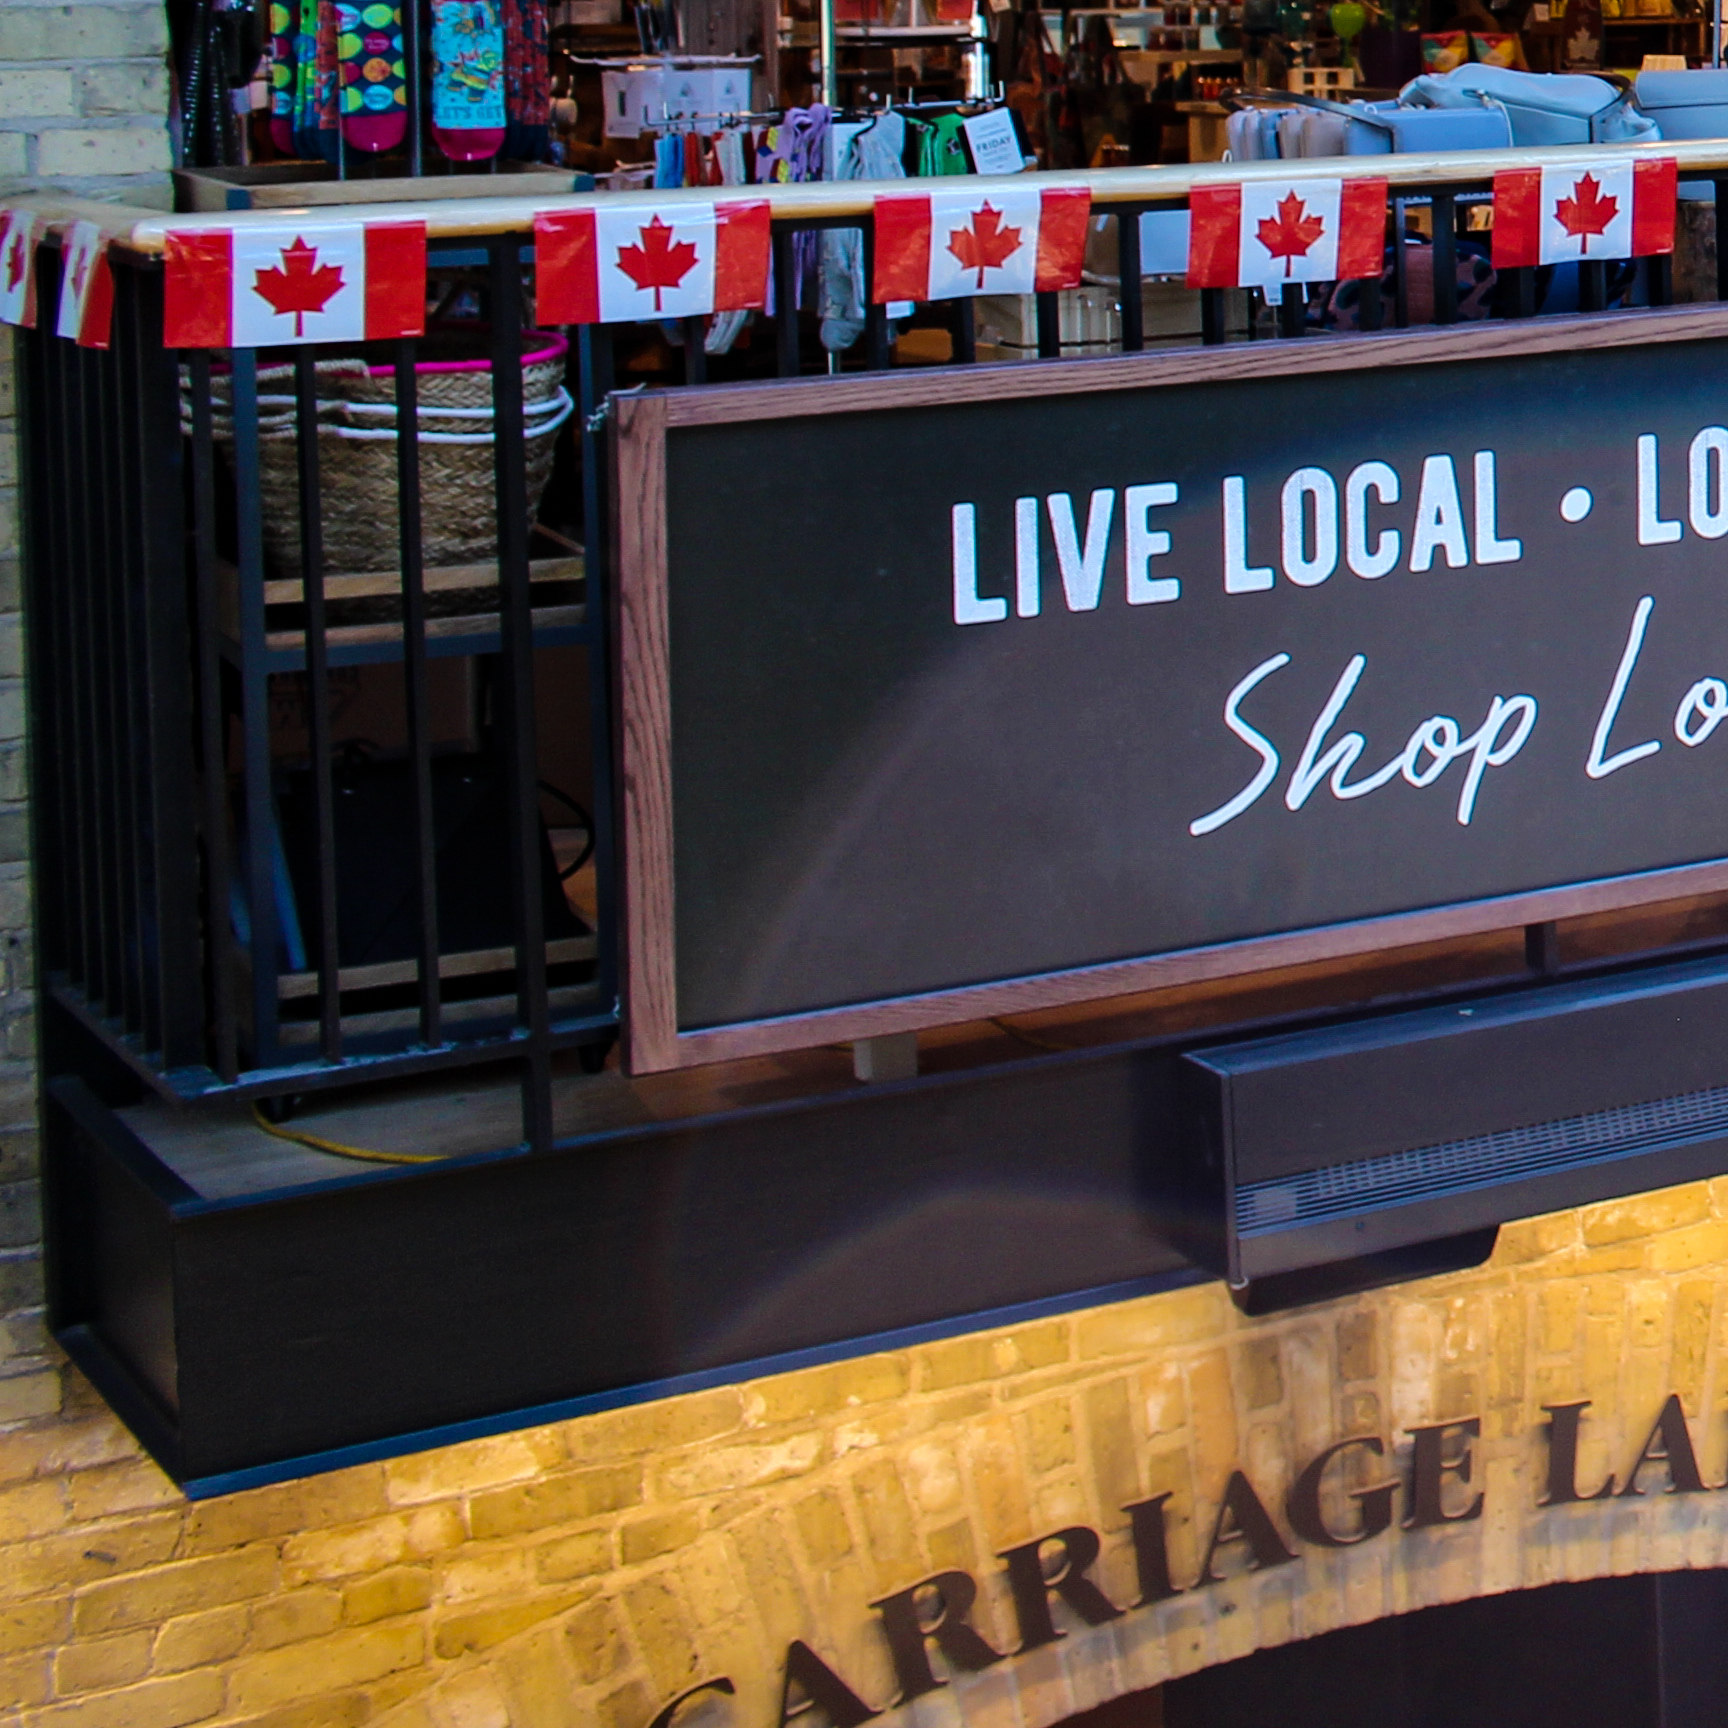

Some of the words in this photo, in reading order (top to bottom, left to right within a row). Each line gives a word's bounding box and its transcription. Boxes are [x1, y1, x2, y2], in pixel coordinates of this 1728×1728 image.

[976, 136, 1011, 152] FRIDAY
[951, 482, 1181, 625] LIVE
[1223, 450, 1523, 595] LOCAL
[1189, 653, 1538, 836] Shop
